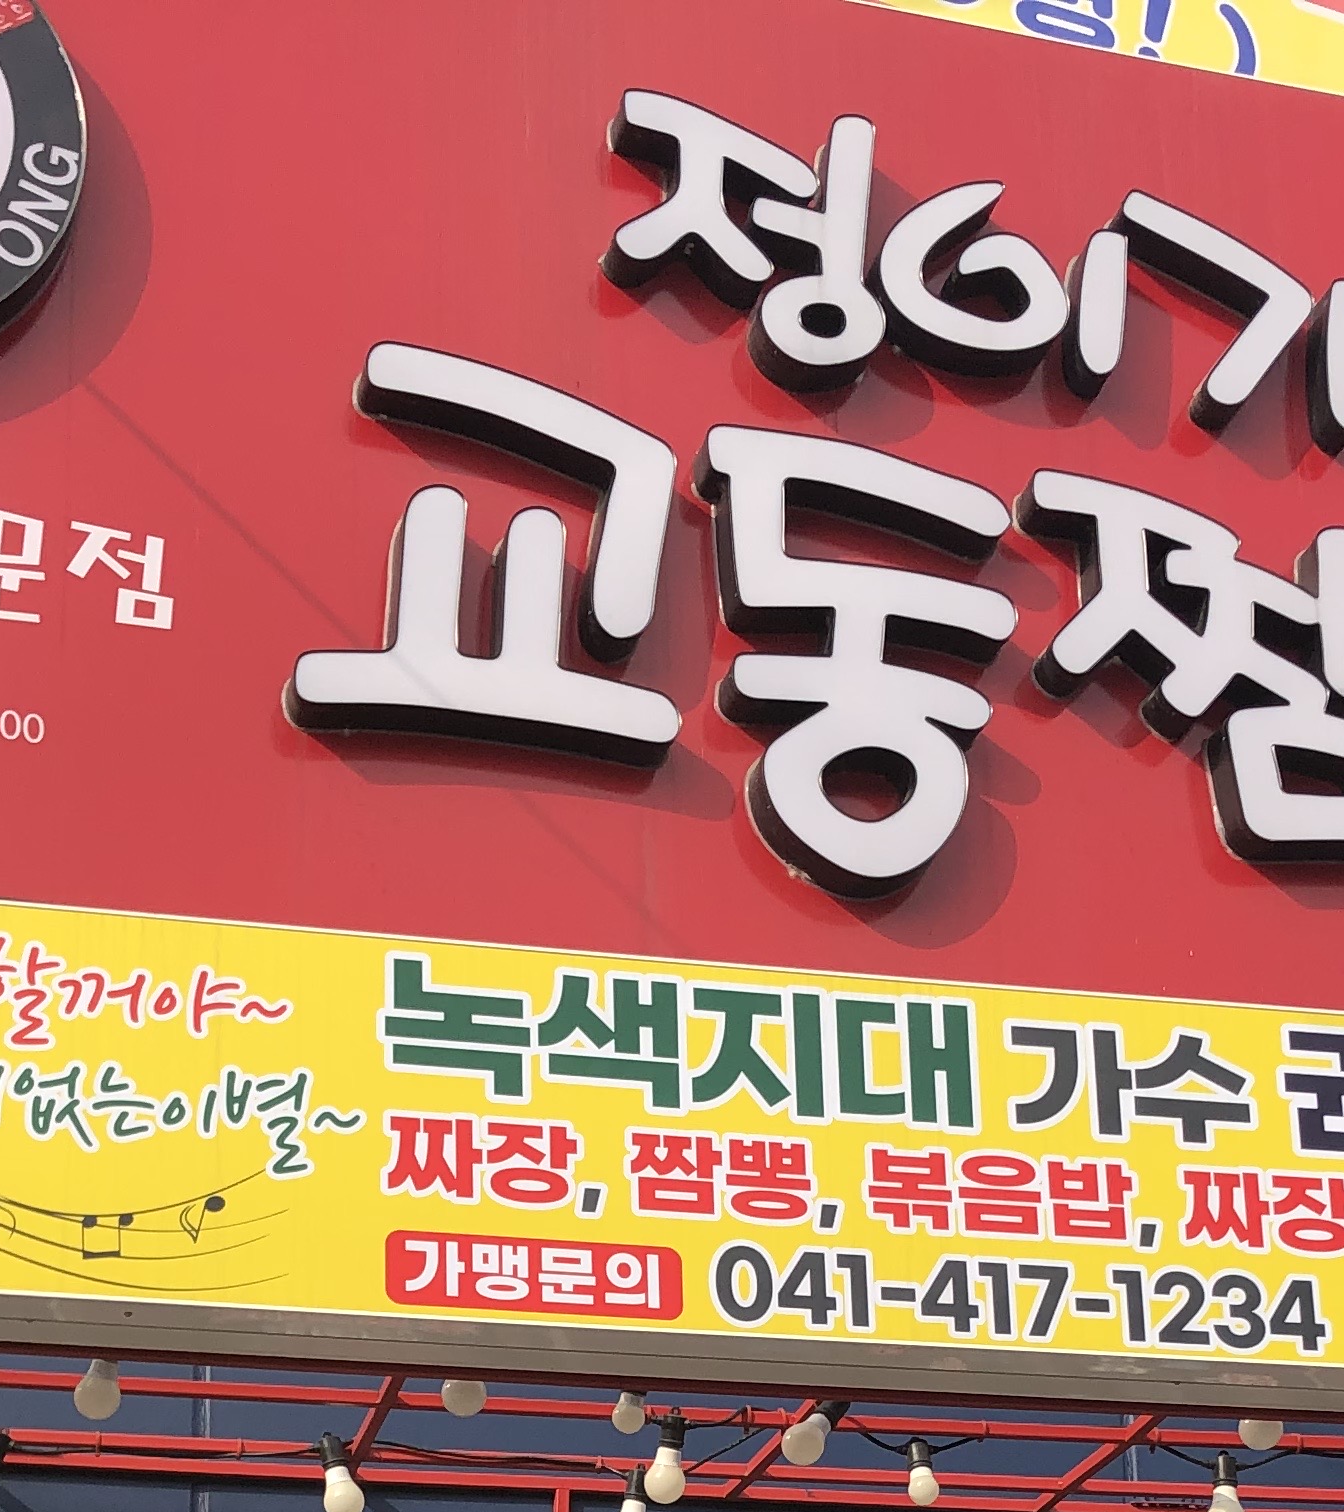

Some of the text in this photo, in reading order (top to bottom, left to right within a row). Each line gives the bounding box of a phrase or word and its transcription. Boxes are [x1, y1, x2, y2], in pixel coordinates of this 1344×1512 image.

[383, 958, 977, 1131] 녹색지대
[1009, 1023, 1253, 1145] 가수
[385, 1116, 604, 1215] 짜장,
[627, 1131, 841, 1232] 짬뽕,
[867, 1148, 1159, 1250] 볶음밥,
[404, 1240, 662, 1311] 가맹문의
[715, 1244, 1326, 1353] 041-417-1234
